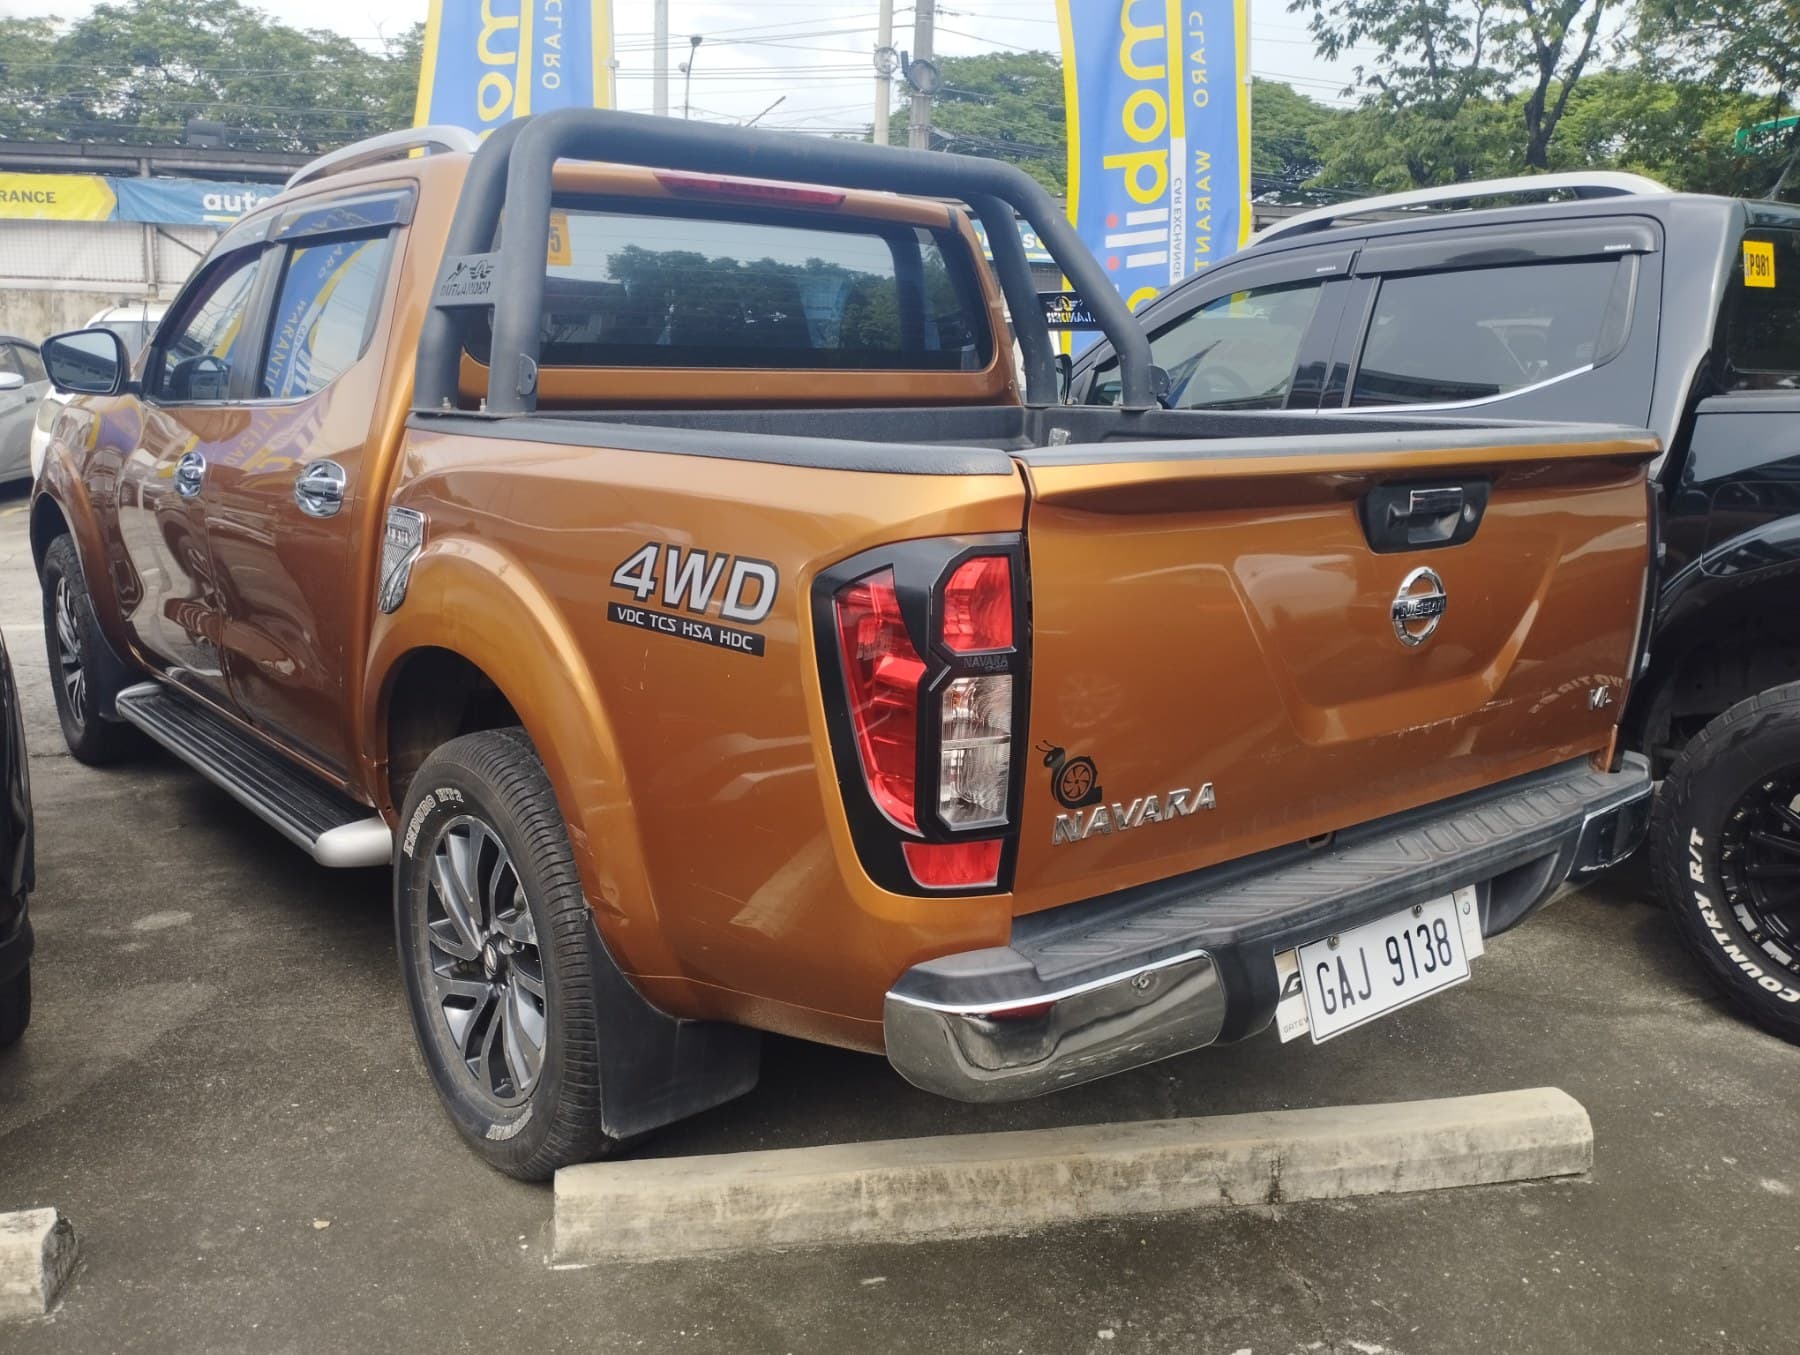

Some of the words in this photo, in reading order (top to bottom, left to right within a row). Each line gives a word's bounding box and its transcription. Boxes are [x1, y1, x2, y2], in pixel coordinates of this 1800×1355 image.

[1749, 253, 1770, 277] P981
[610, 541, 780, 625] 4WD
[1401, 599, 1445, 616] NISSAN
[617, 607, 645, 625] VDC
[649, 613, 677, 633] TCS
[682, 621, 713, 642] HSA
[719, 629, 753, 651] HDC
[964, 655, 1008, 668] NAVARA
[1053, 782, 1216, 845] NAVARA
[1689, 826, 1705, 884] R/T
[1316, 946, 1372, 1016] GAJ
[1385, 917, 1452, 987] 9138
[1694, 890, 1800, 1003] COUNTRY
